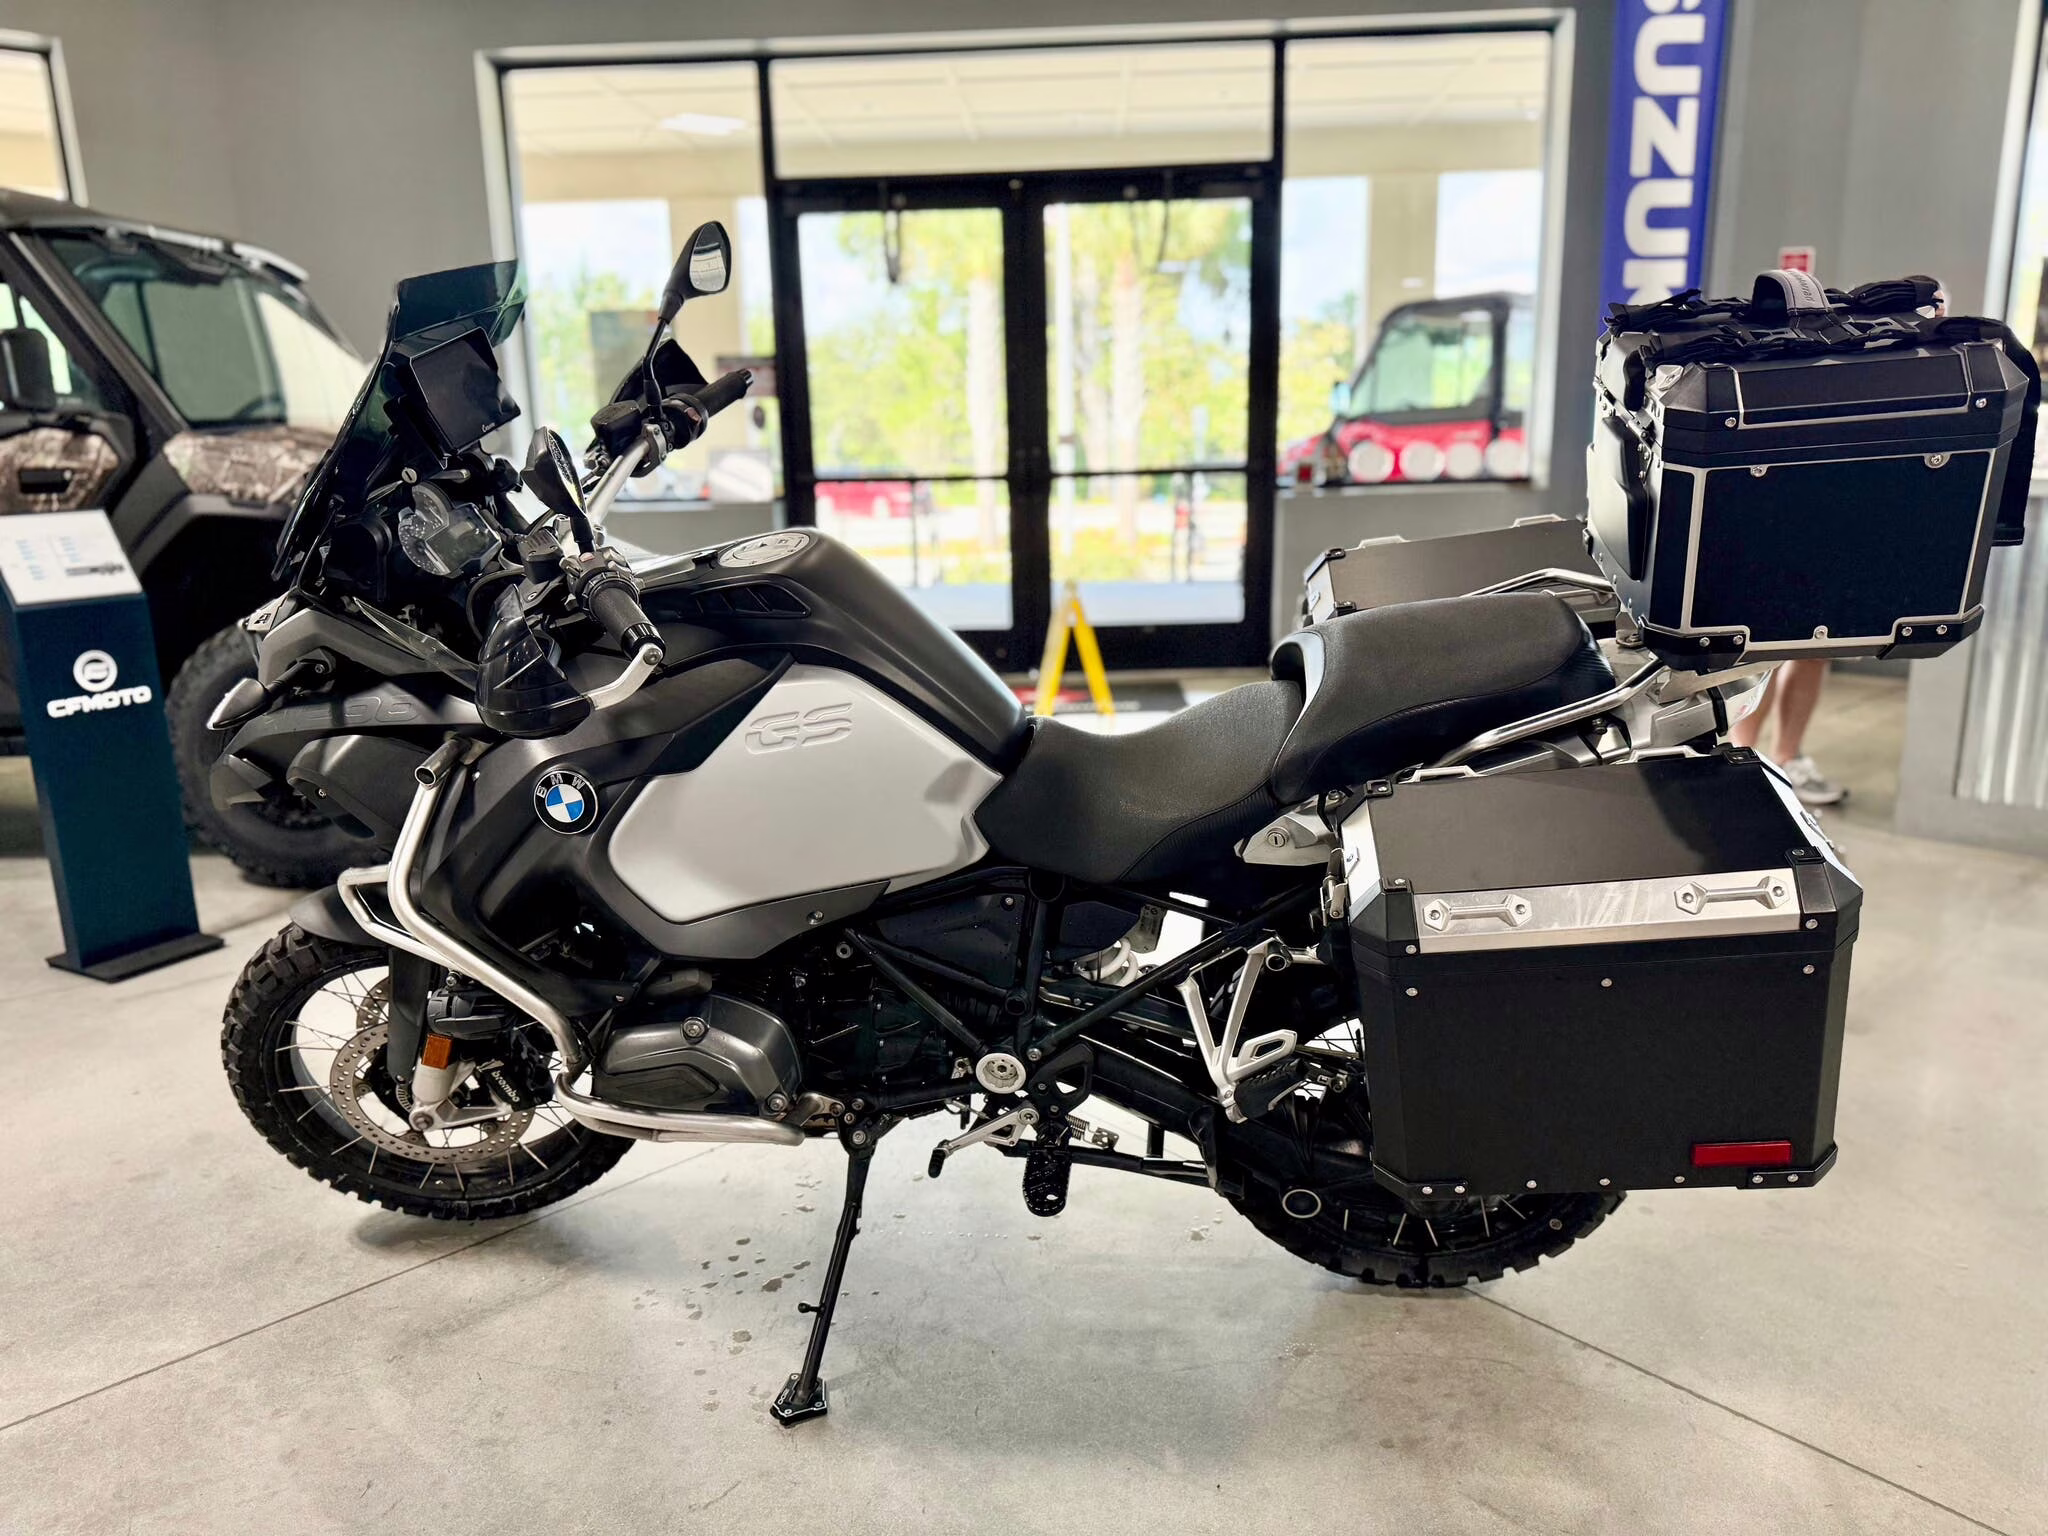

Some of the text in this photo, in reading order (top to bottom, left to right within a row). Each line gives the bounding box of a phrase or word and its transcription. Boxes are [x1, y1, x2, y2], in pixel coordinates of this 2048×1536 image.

[1622, 0, 1706, 307] UZUK
[47, 685, 152, 718] CFMOTO
[745, 703, 852, 755] GS
[536, 773, 586, 799] BMW
[491, 1070, 520, 1102] brembo
